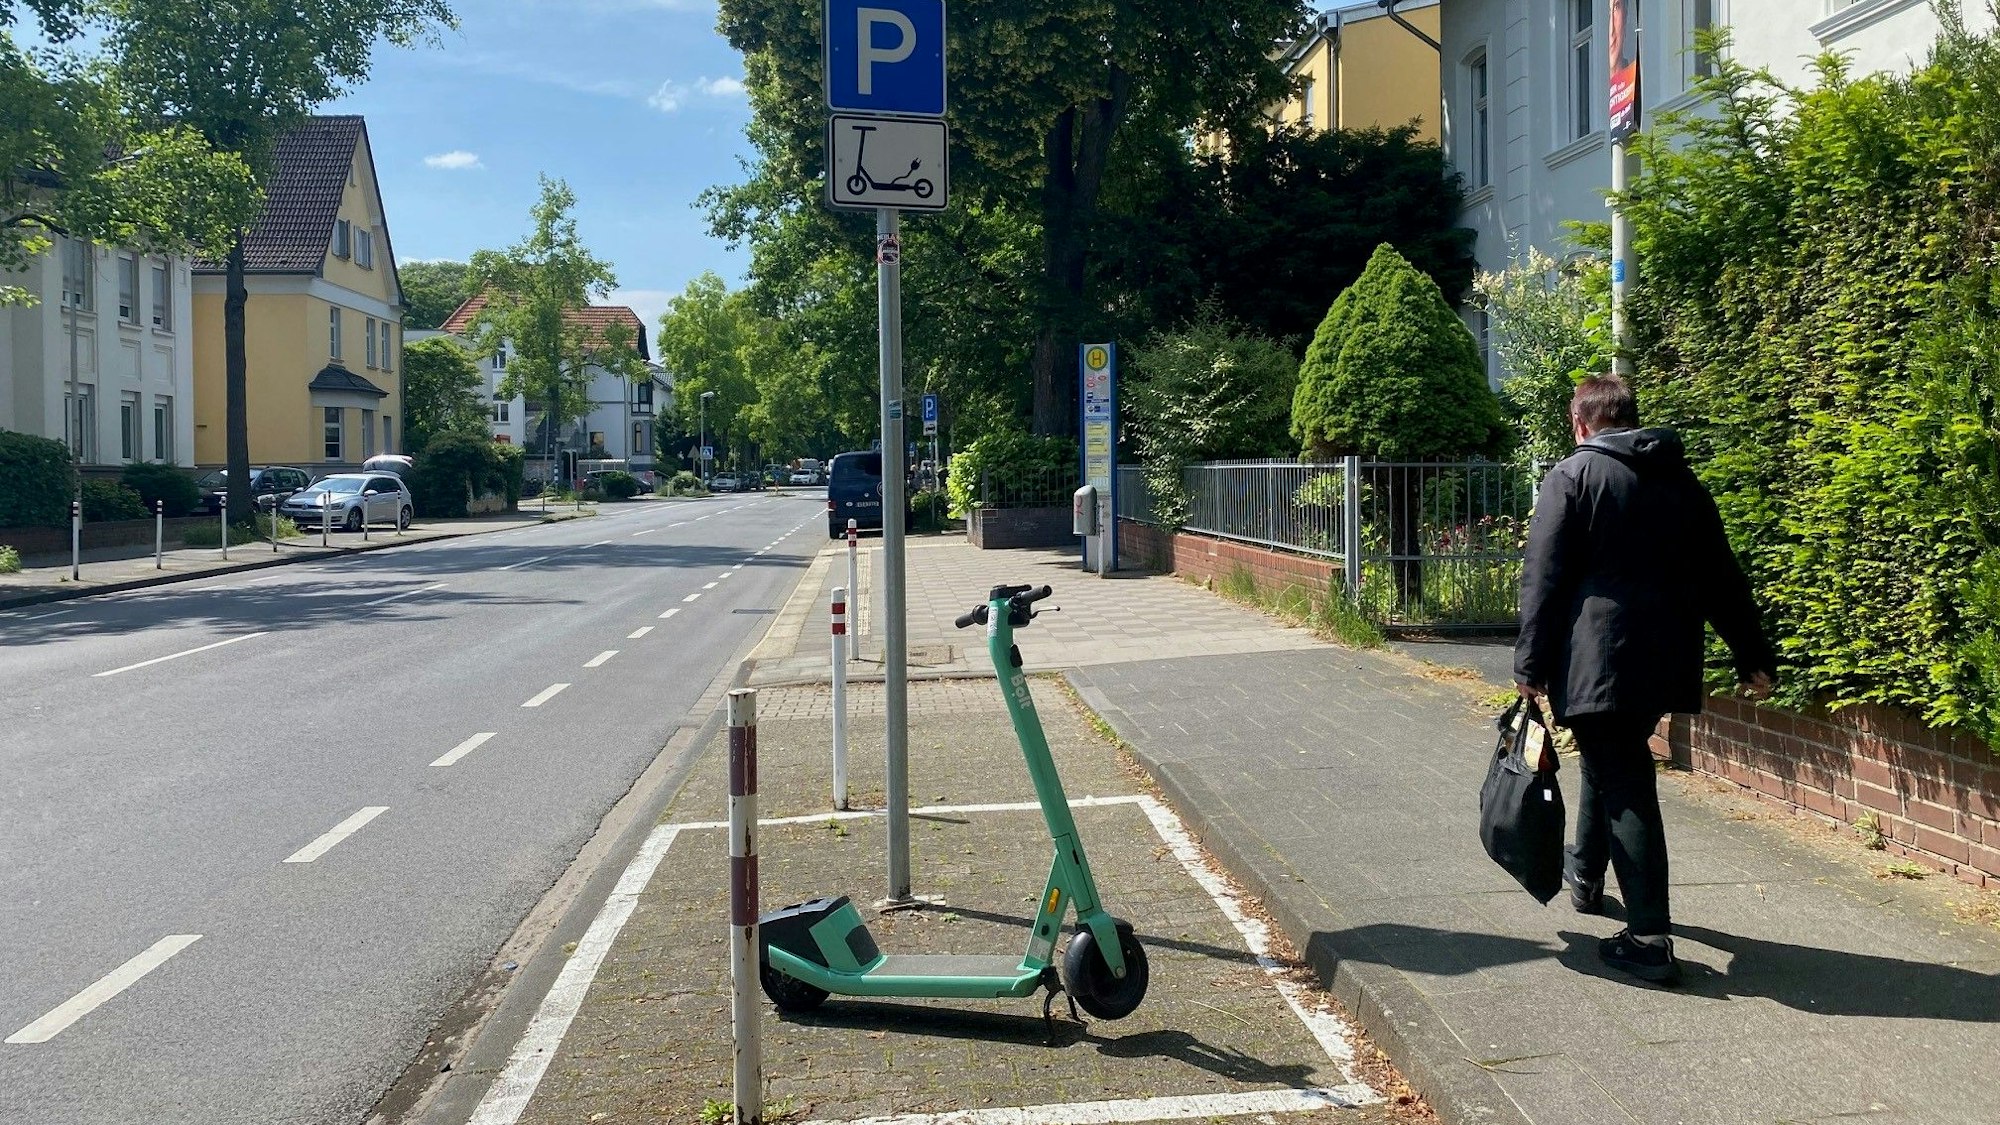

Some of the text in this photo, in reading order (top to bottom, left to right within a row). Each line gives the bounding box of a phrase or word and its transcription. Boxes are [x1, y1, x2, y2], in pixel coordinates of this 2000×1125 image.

[857, 7, 917, 95] P
[1092, 351, 1101, 366] H
[926, 398, 934, 418] P
[1011, 673, 1031, 708] Bolt
